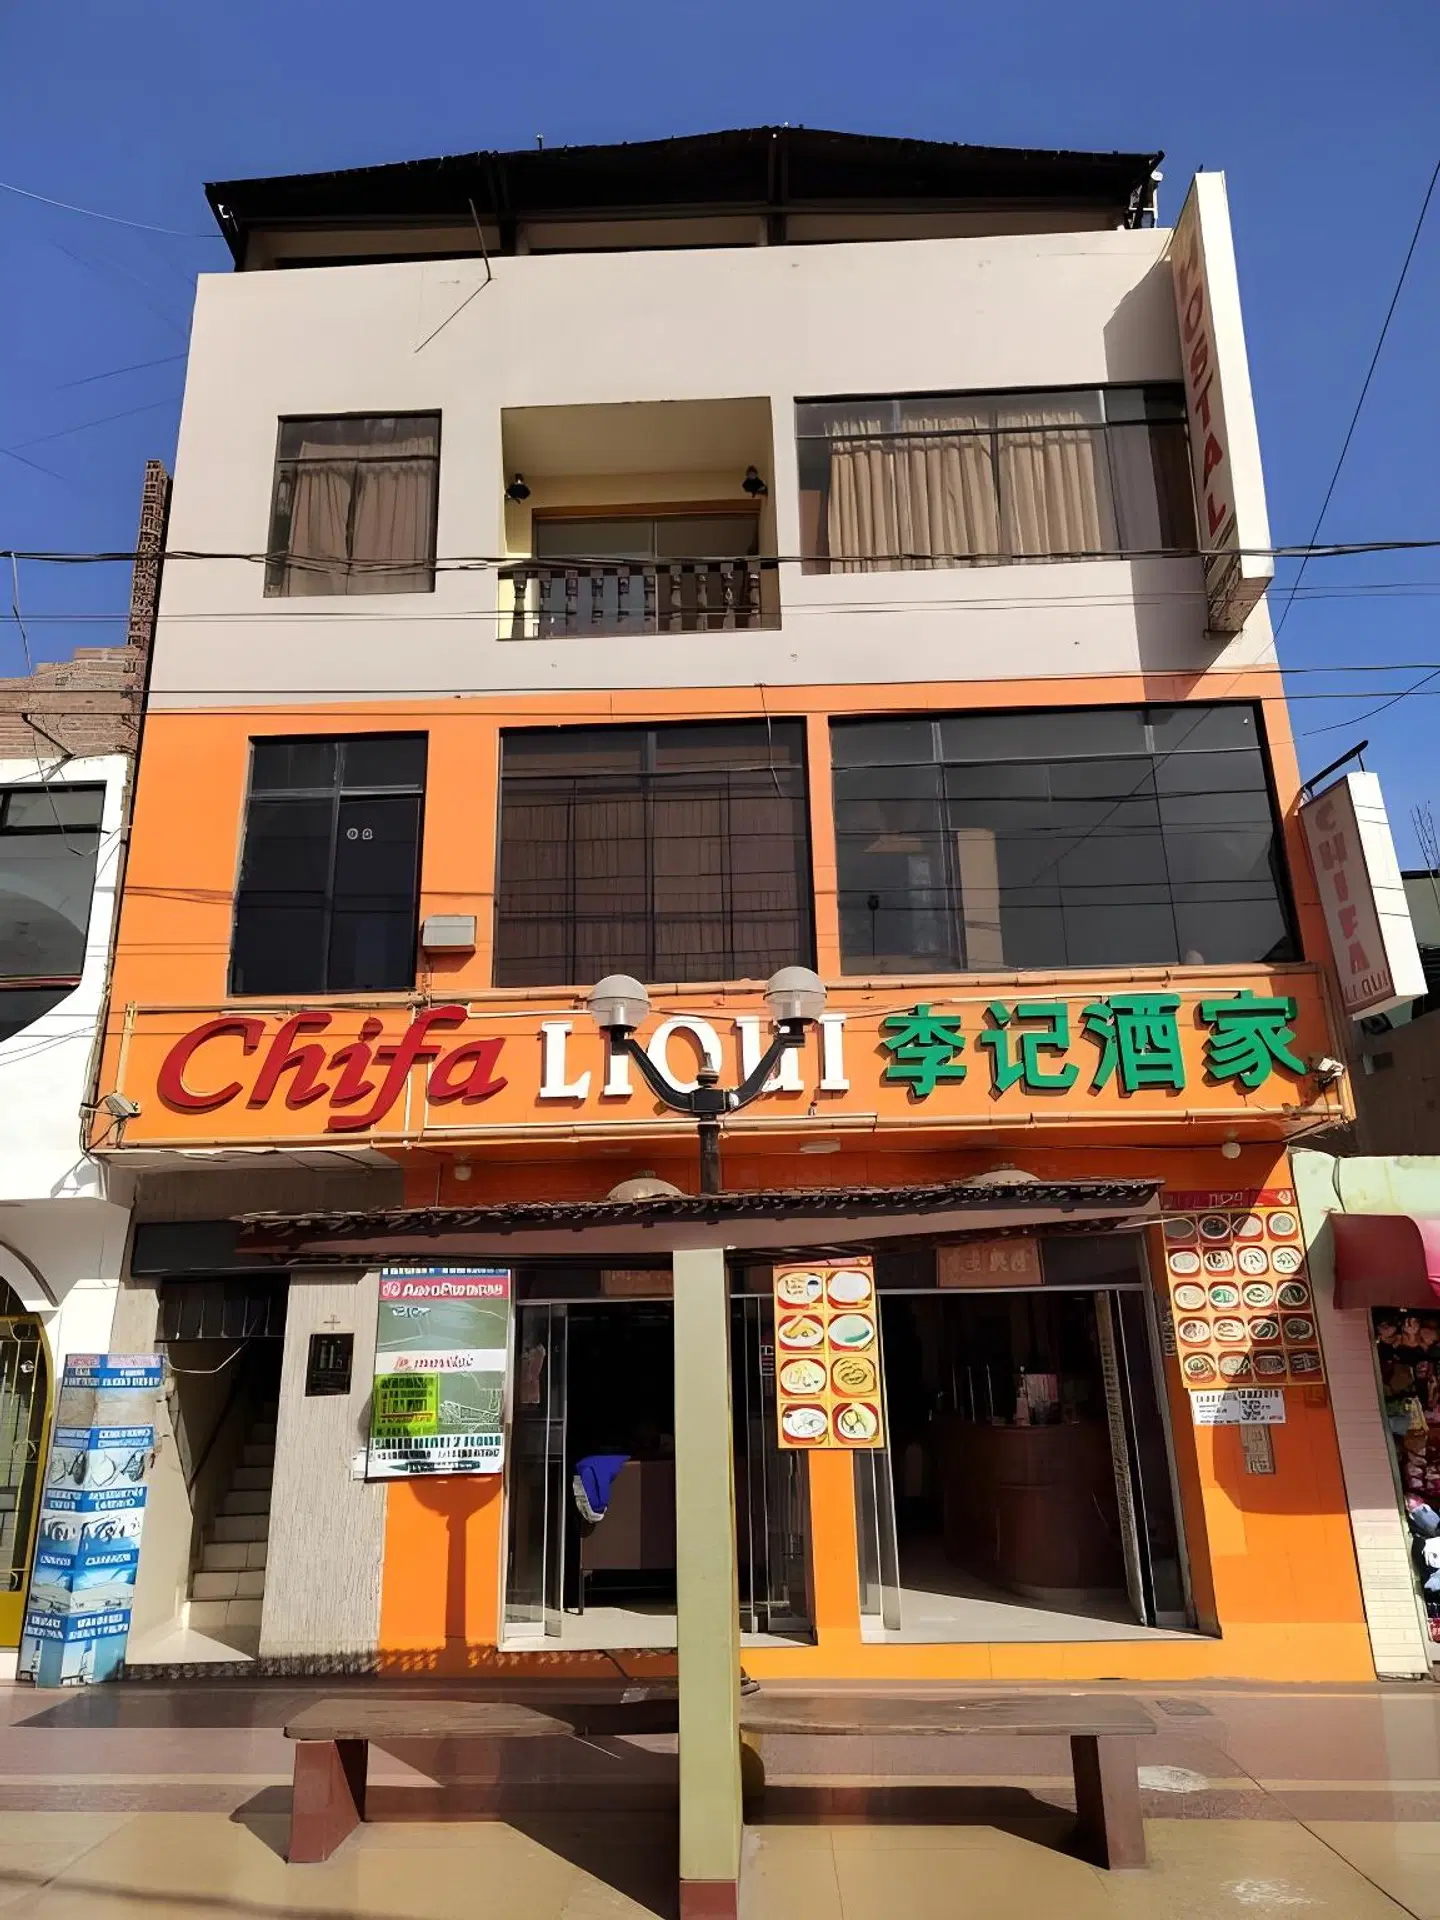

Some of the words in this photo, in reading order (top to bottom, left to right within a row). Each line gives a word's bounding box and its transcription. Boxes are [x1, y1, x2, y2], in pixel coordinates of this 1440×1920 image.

[1177, 231, 1227, 538] HOSTAL
[1315, 798, 1371, 975] CHIFA
[157, 1004, 508, 1133] Chifa
[882, 988, 1308, 1097] 李记酒家
